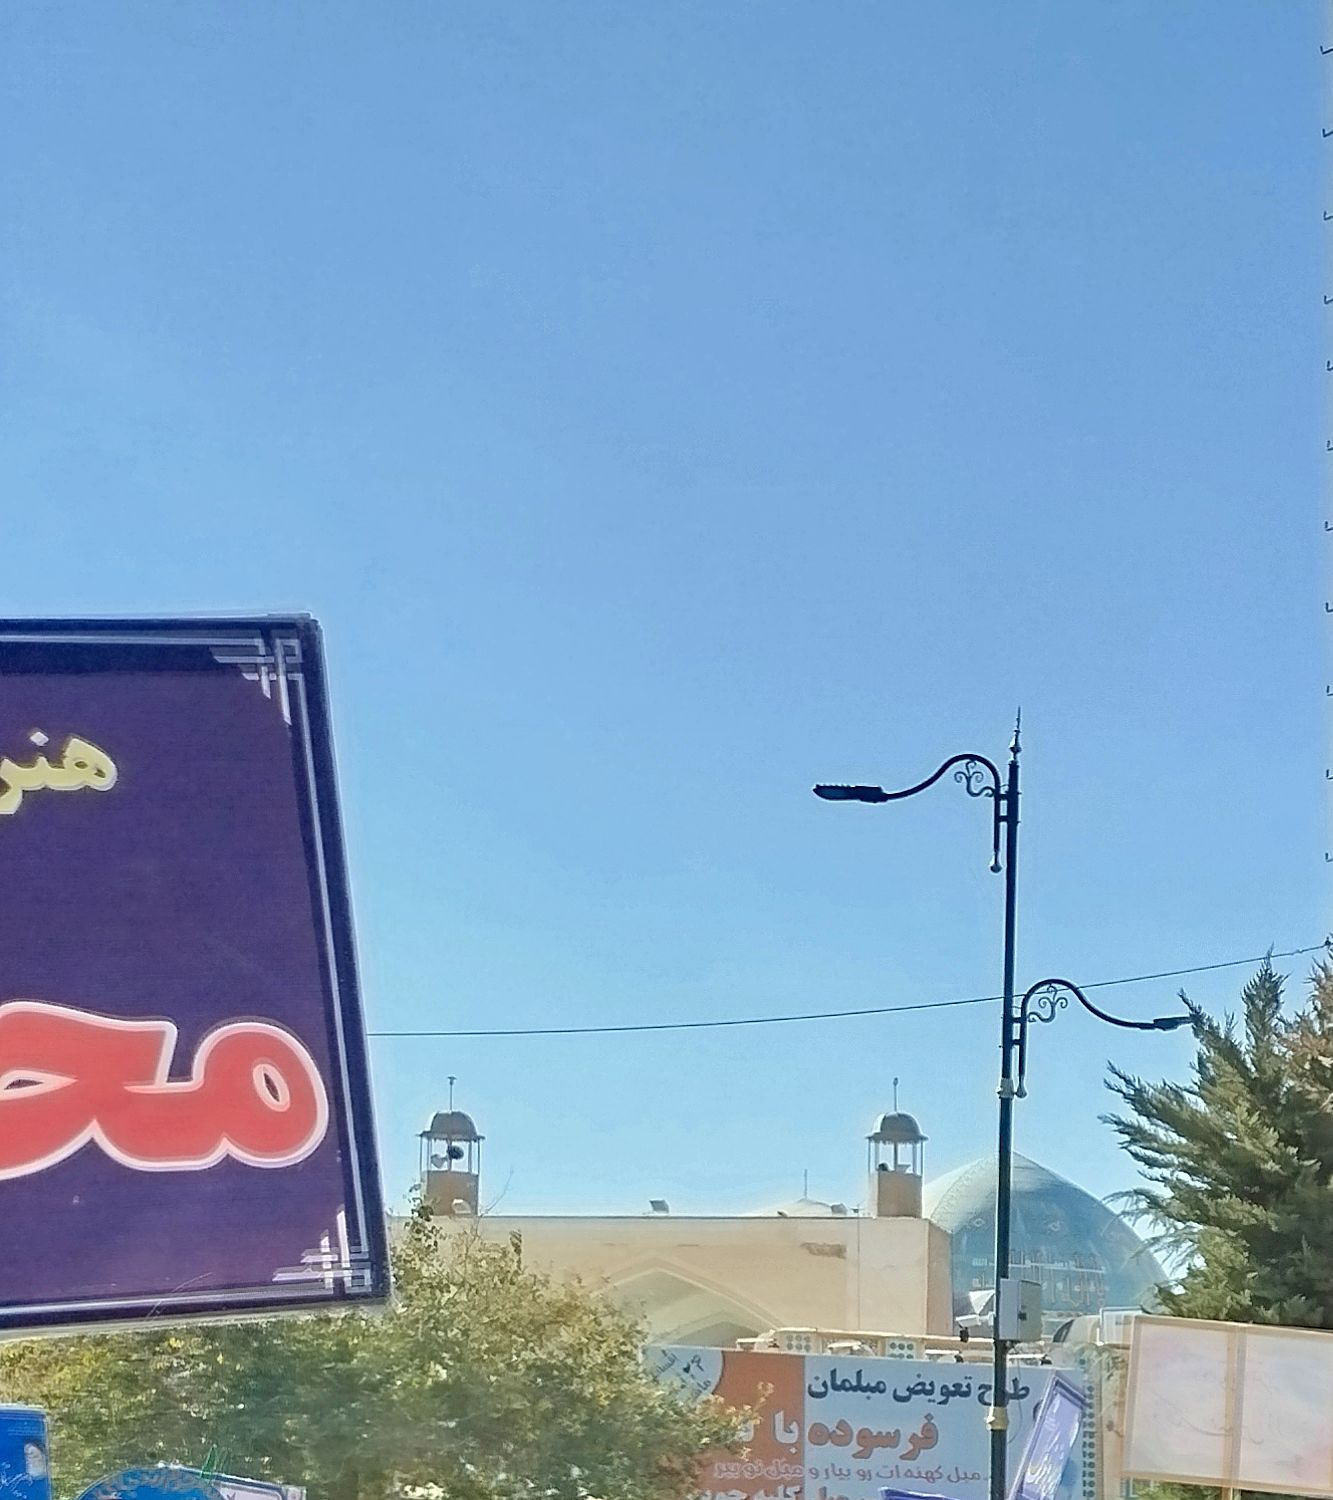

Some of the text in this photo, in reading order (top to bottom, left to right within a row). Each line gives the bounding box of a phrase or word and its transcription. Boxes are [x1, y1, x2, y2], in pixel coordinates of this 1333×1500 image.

[807, 1367, 1031, 1407] طح تعویض مبلمان
[774, 1410, 800, 1455] با
[806, 1411, 940, 1461] فرسوده
